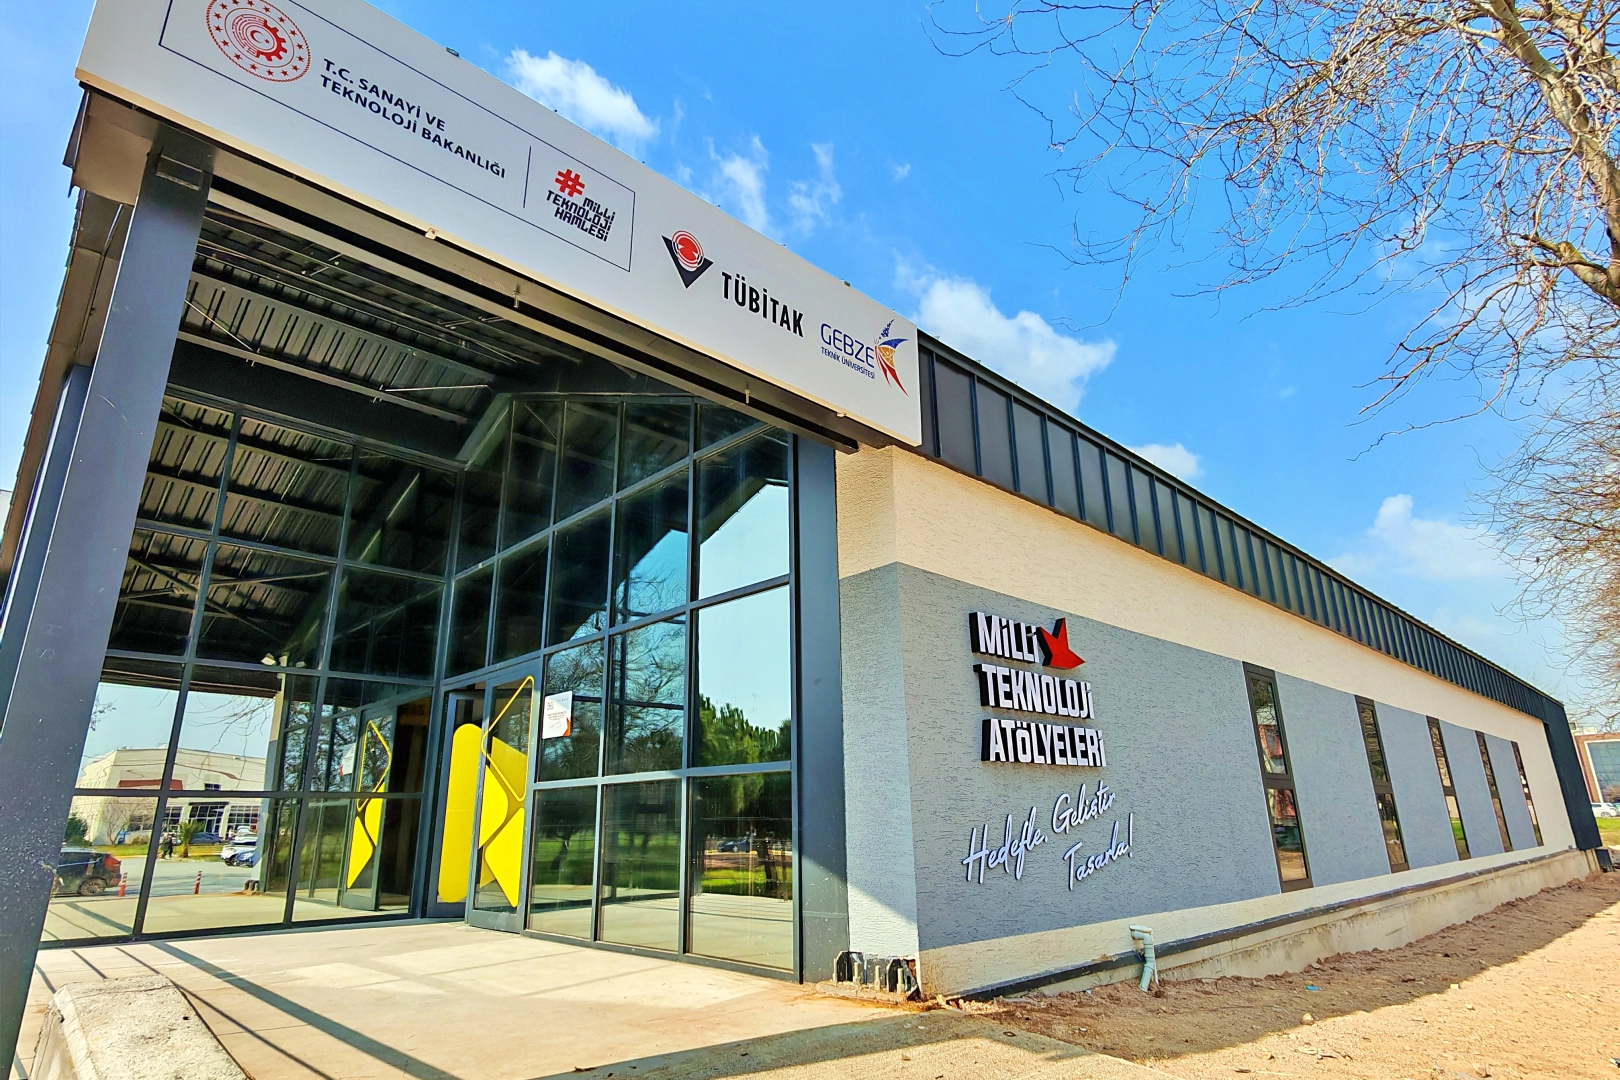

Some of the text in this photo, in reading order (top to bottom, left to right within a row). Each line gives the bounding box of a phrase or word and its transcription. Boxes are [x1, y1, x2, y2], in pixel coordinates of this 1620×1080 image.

[320, 74, 506, 178] TEKNOLOJİ BAKANLIĞI
[323, 58, 446, 132] T.C. SANAYİ VE
[721, 271, 803, 338] TÜBİTAK
[820, 323, 875, 369] GEBZE
